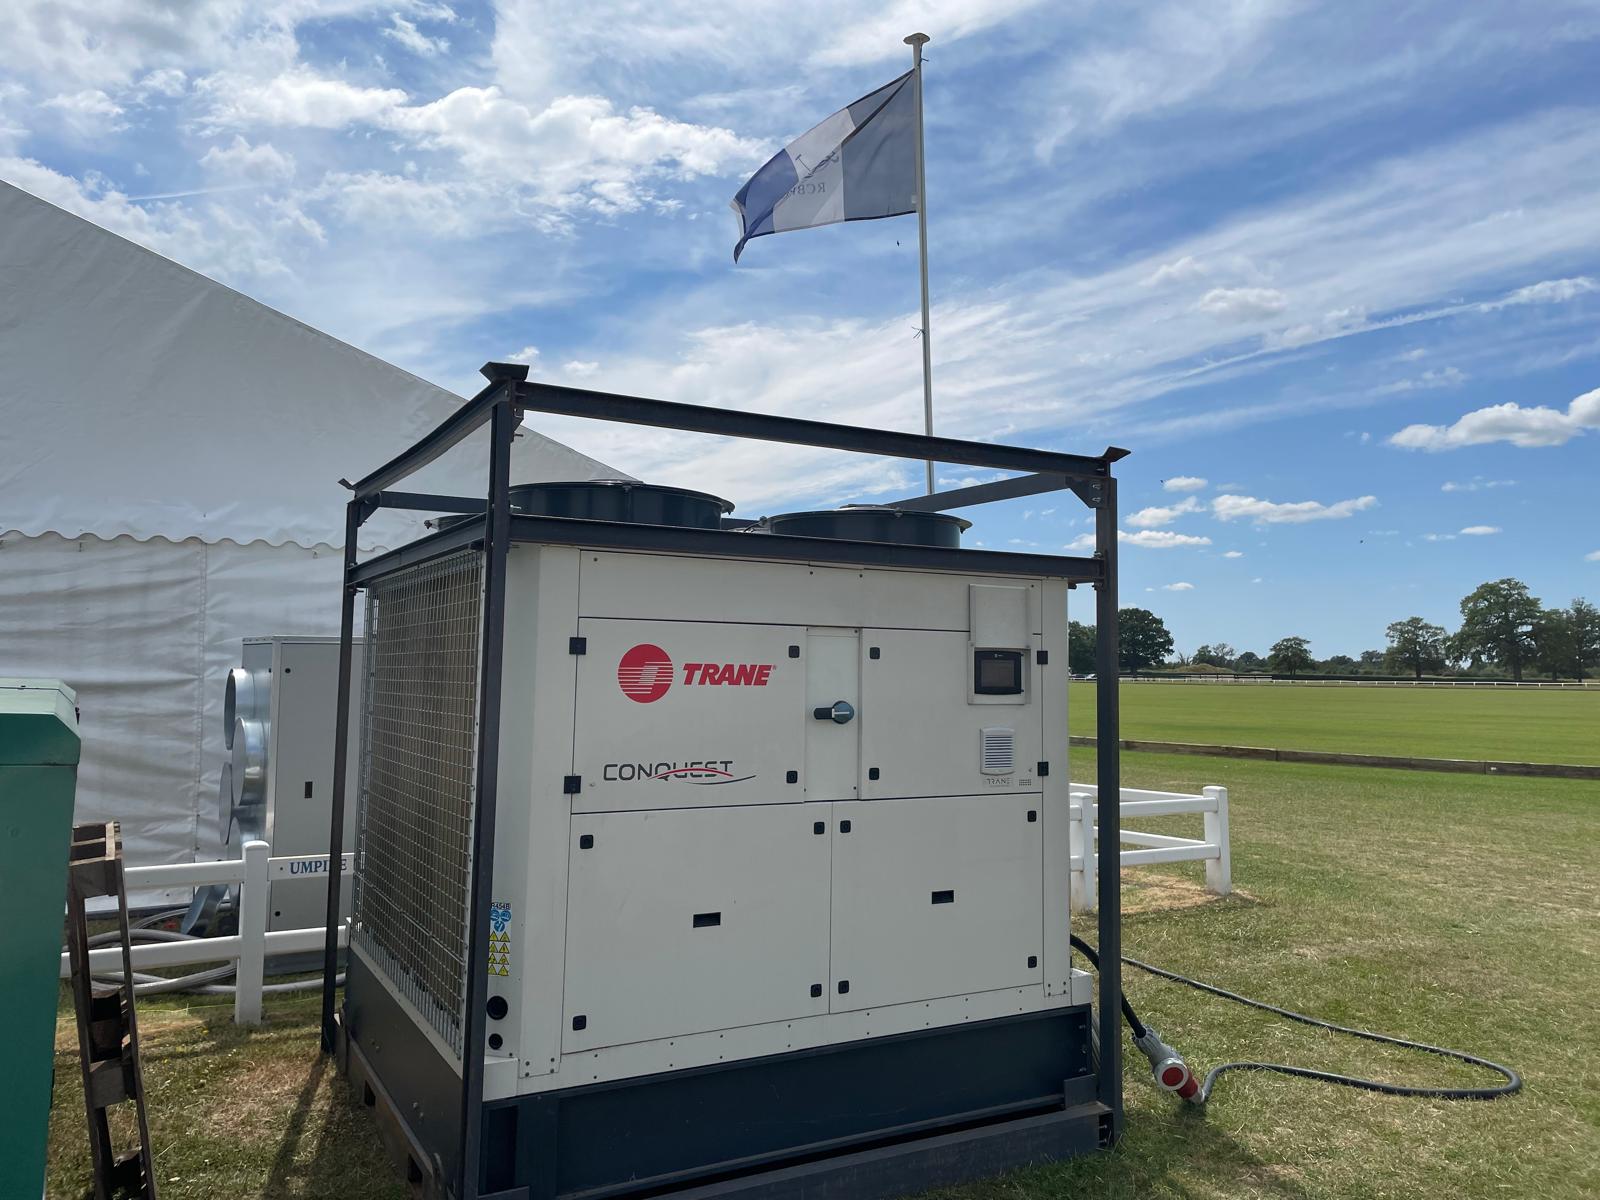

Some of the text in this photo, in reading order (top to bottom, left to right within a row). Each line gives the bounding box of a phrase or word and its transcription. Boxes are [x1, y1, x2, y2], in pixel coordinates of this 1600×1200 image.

[682, 662, 773, 686] TRANE
[603, 760, 733, 781] CONQUEST
[289, 858, 347, 875] UMPIE
